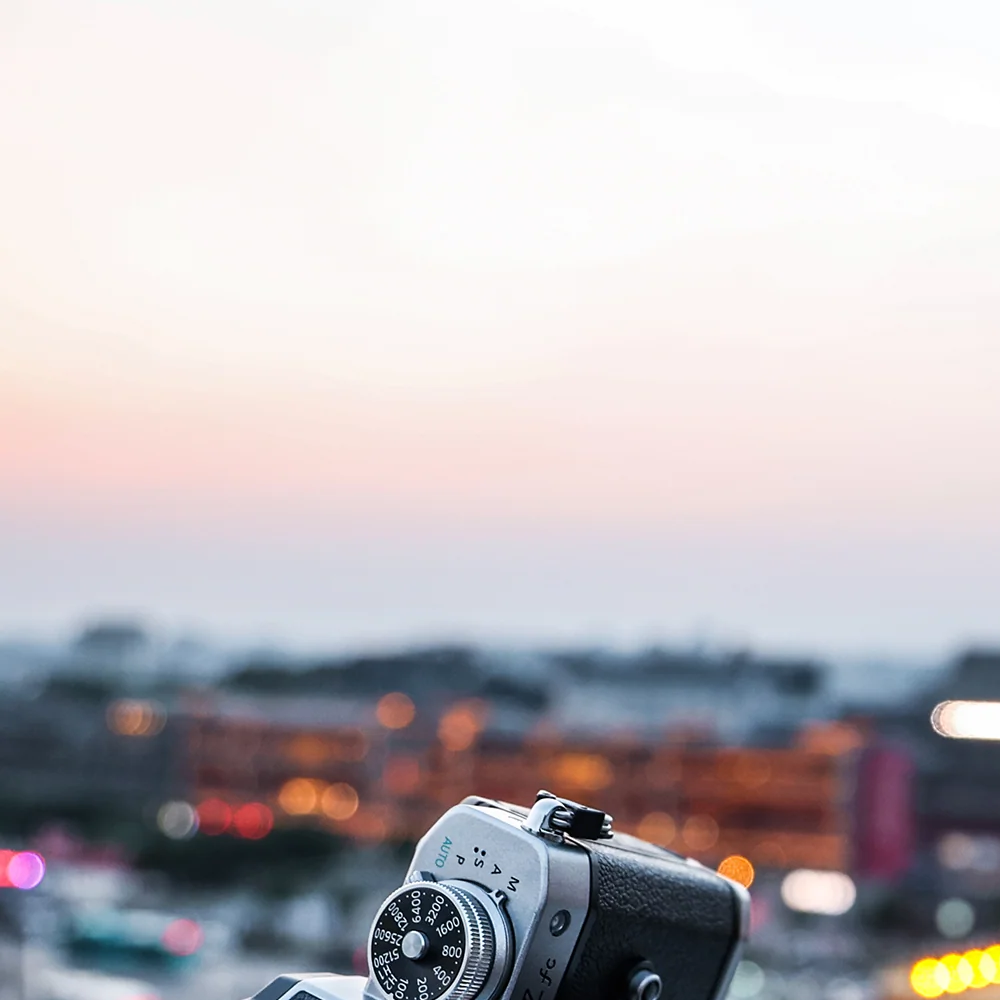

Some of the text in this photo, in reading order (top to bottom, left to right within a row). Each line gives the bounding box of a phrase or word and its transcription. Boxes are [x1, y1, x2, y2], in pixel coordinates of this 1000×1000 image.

[434, 836, 520, 892] AUTO P S A M
[388, 902, 408, 931] 12800
[411, 890, 421, 923] 6400
[425, 896, 444, 926] 3200
[374, 928, 403, 946] 25600
[436, 916, 460, 937] 1600
[374, 948, 400, 968] 51200
[442, 945, 462, 958] 800
[433, 966, 451, 986] 400
[395, 978, 408, 999] 100
[417, 977, 428, 1000] 200
